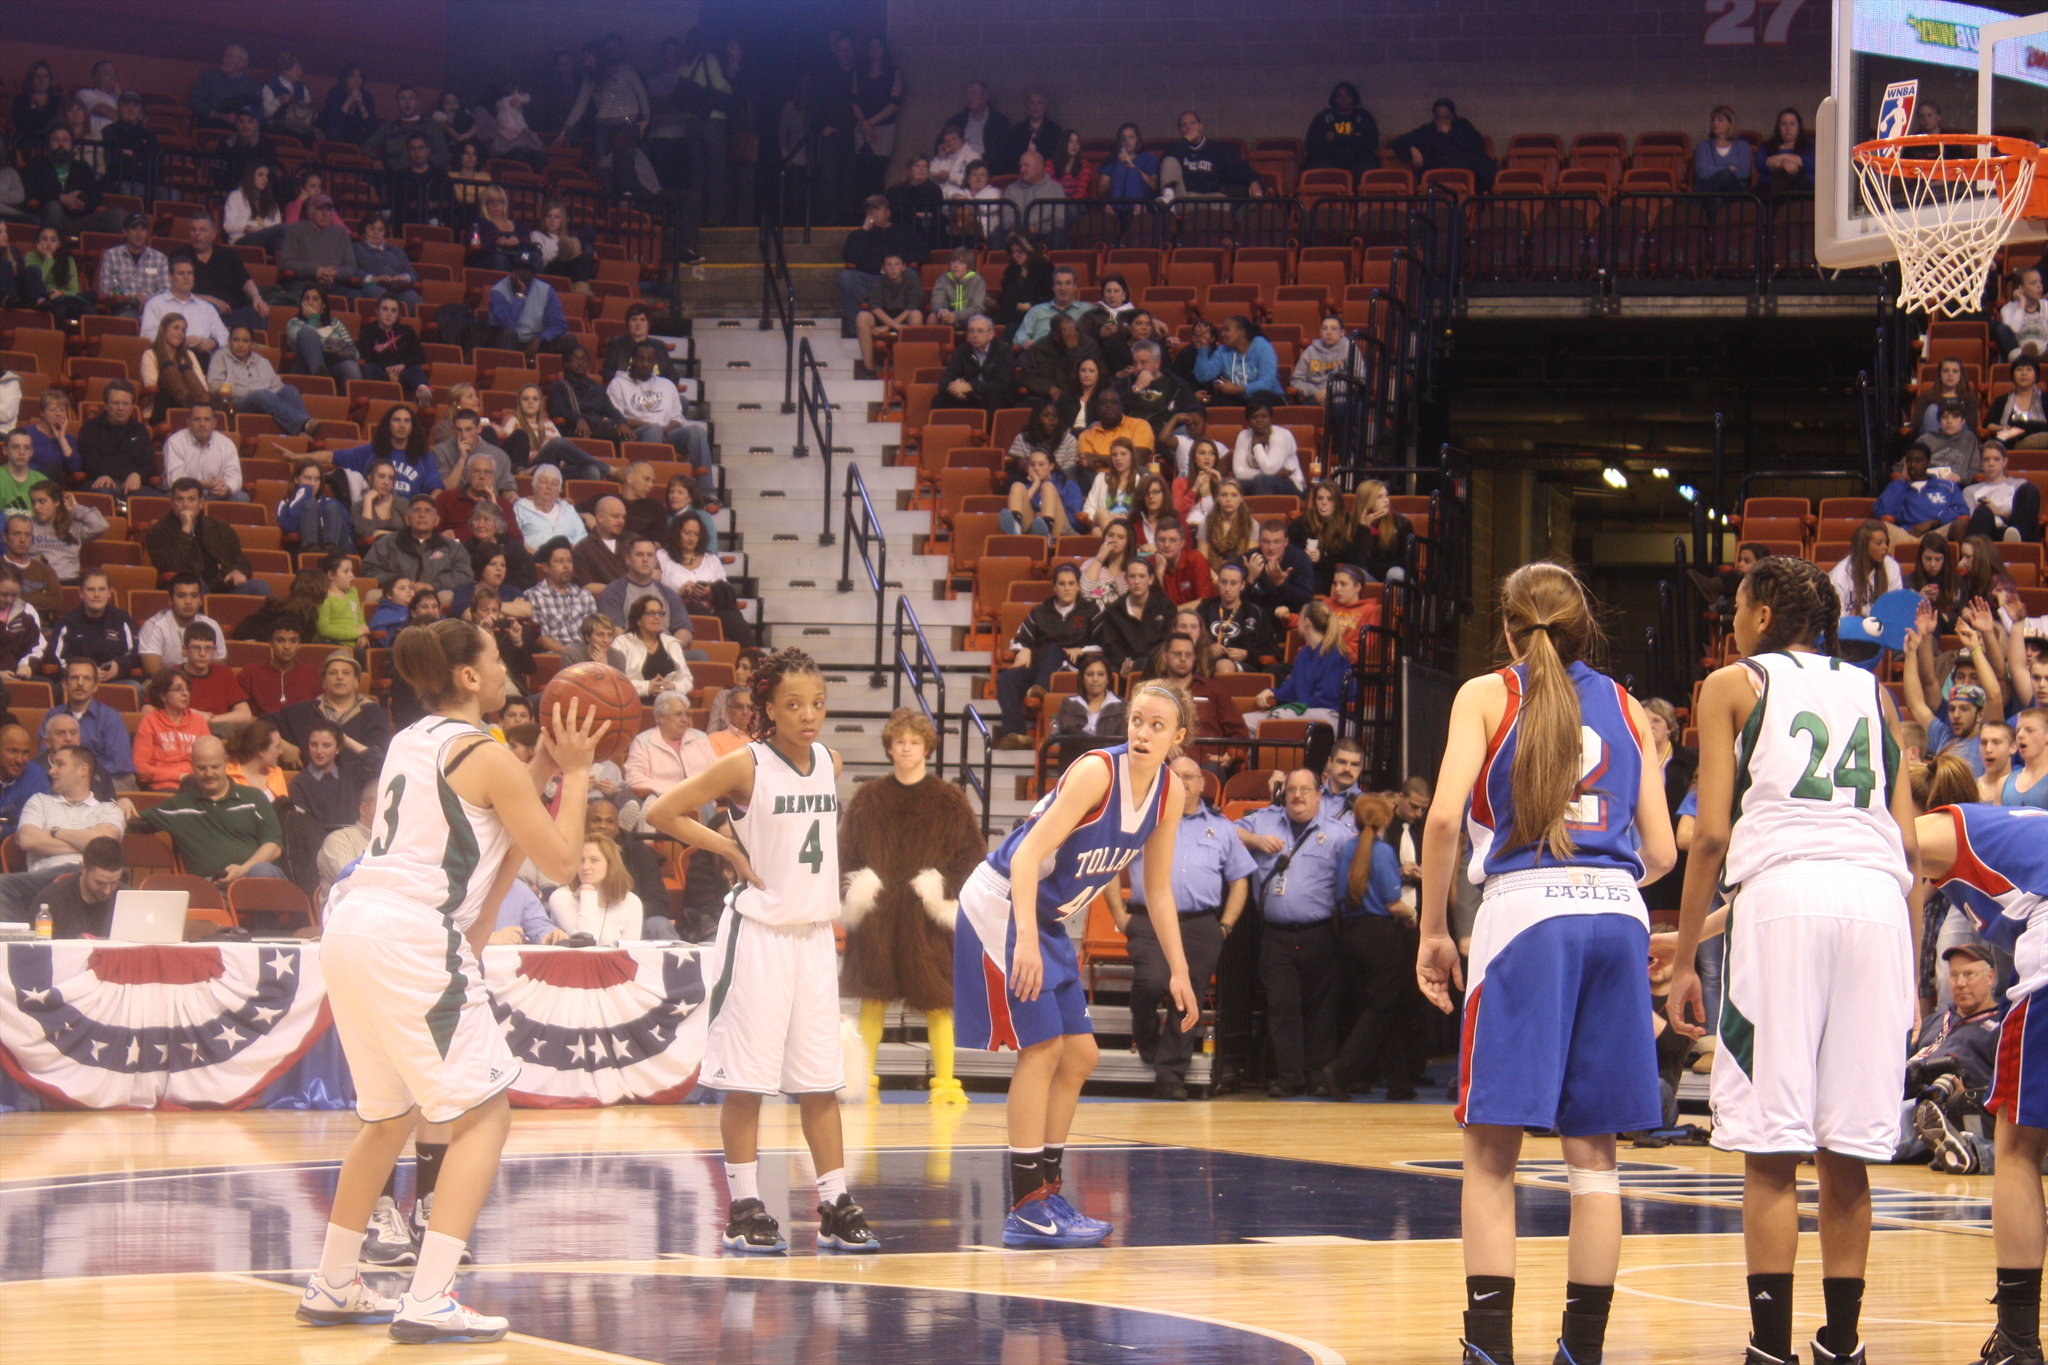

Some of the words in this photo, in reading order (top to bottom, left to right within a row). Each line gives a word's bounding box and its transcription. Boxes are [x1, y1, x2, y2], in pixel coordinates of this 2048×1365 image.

[1703, 0, 1807, 45] 27
[1887, 85, 1915, 99] WNBA
[1789, 710, 1875, 809] 24
[371, 773, 406, 857] 3
[798, 818, 823, 874] 4
[1544, 884, 1631, 903] EAGLES
